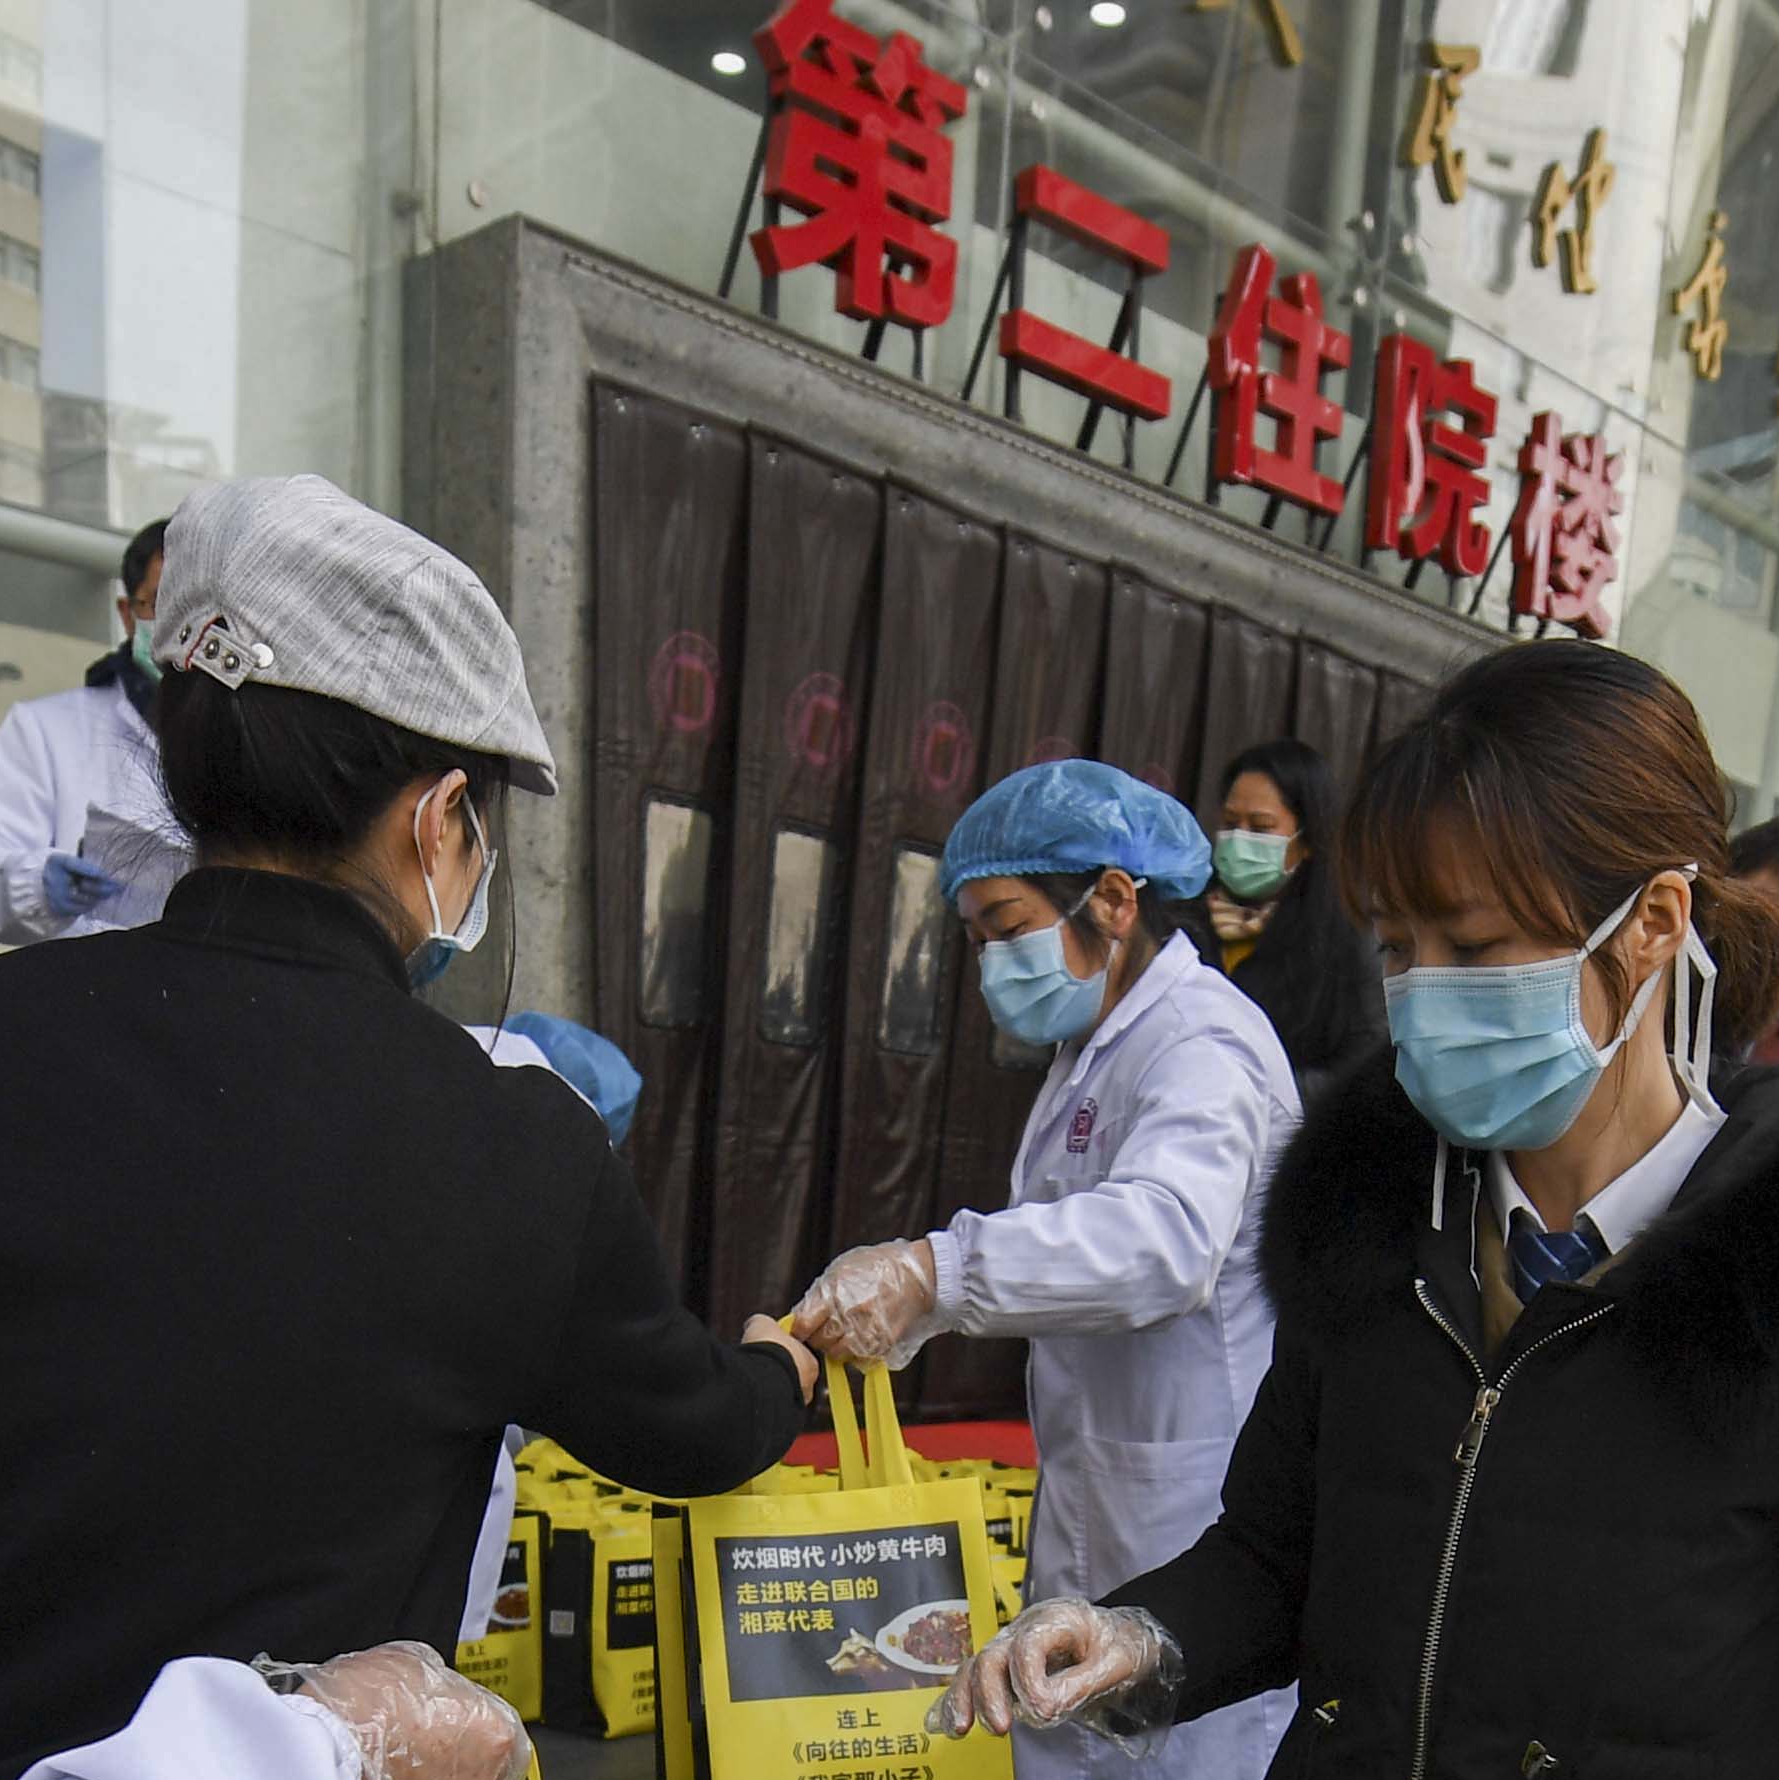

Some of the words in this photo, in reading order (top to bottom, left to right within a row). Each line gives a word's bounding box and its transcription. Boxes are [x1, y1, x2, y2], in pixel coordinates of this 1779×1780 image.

[750, 0, 1619, 640] 第二住院楼
[731, 1545, 826, 1571] 炊烟时代
[831, 1534, 947, 1566] 小炒黄牛肉
[737, 1577, 879, 1605] 走进联合国的
[739, 1607, 835, 1635] 湘菜代表
[836, 1708, 882, 1730] 连上
[792, 1733, 932, 1764] 《向往的生活》
